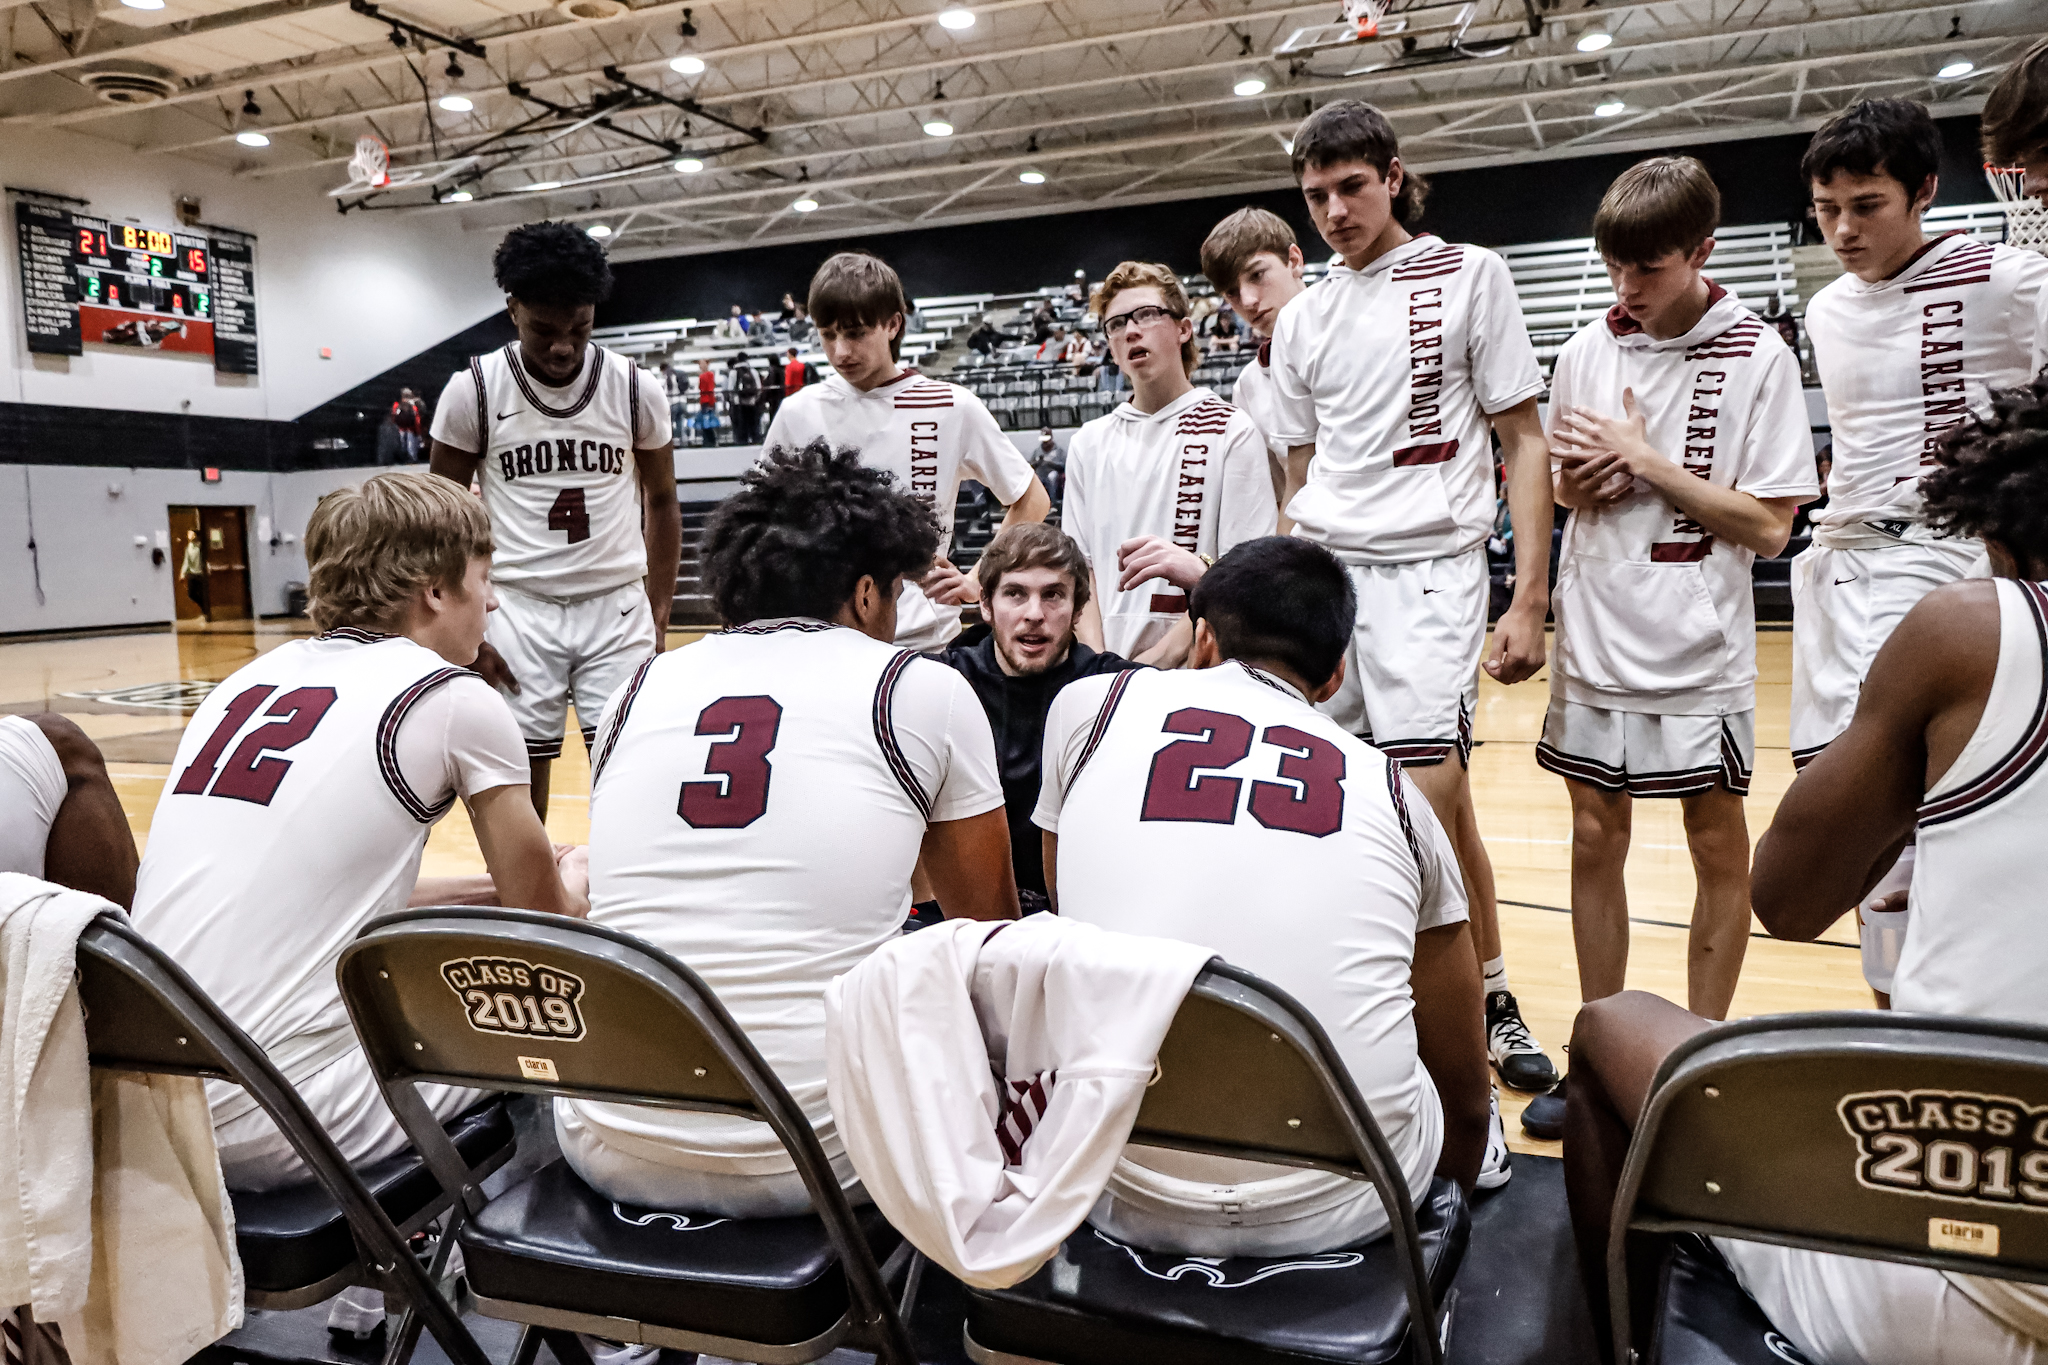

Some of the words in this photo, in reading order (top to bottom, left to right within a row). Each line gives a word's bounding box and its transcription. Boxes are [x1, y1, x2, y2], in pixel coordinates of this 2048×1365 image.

[80, 229, 107, 256] 21
[124, 225, 173, 255] 8:00
[150, 257, 163, 277] 2
[188, 249, 208, 272] 15
[88, 277, 100, 297] 2
[198, 293, 210, 312] 2
[1408, 287, 1442, 438] CLARENDON
[499, 438, 625, 482] BRONCOS
[548, 487, 590, 544] 4
[1889, 522, 1902, 532] XL
[172, 684, 339, 807] 12
[677, 695, 783, 829] 3
[1140, 707, 1347, 839] 23
[449, 964, 531, 989] CLASS
[539, 972, 577, 998] OF
[466, 989, 577, 1034] 2019
[1853, 1102, 2017, 1137] CLASS
